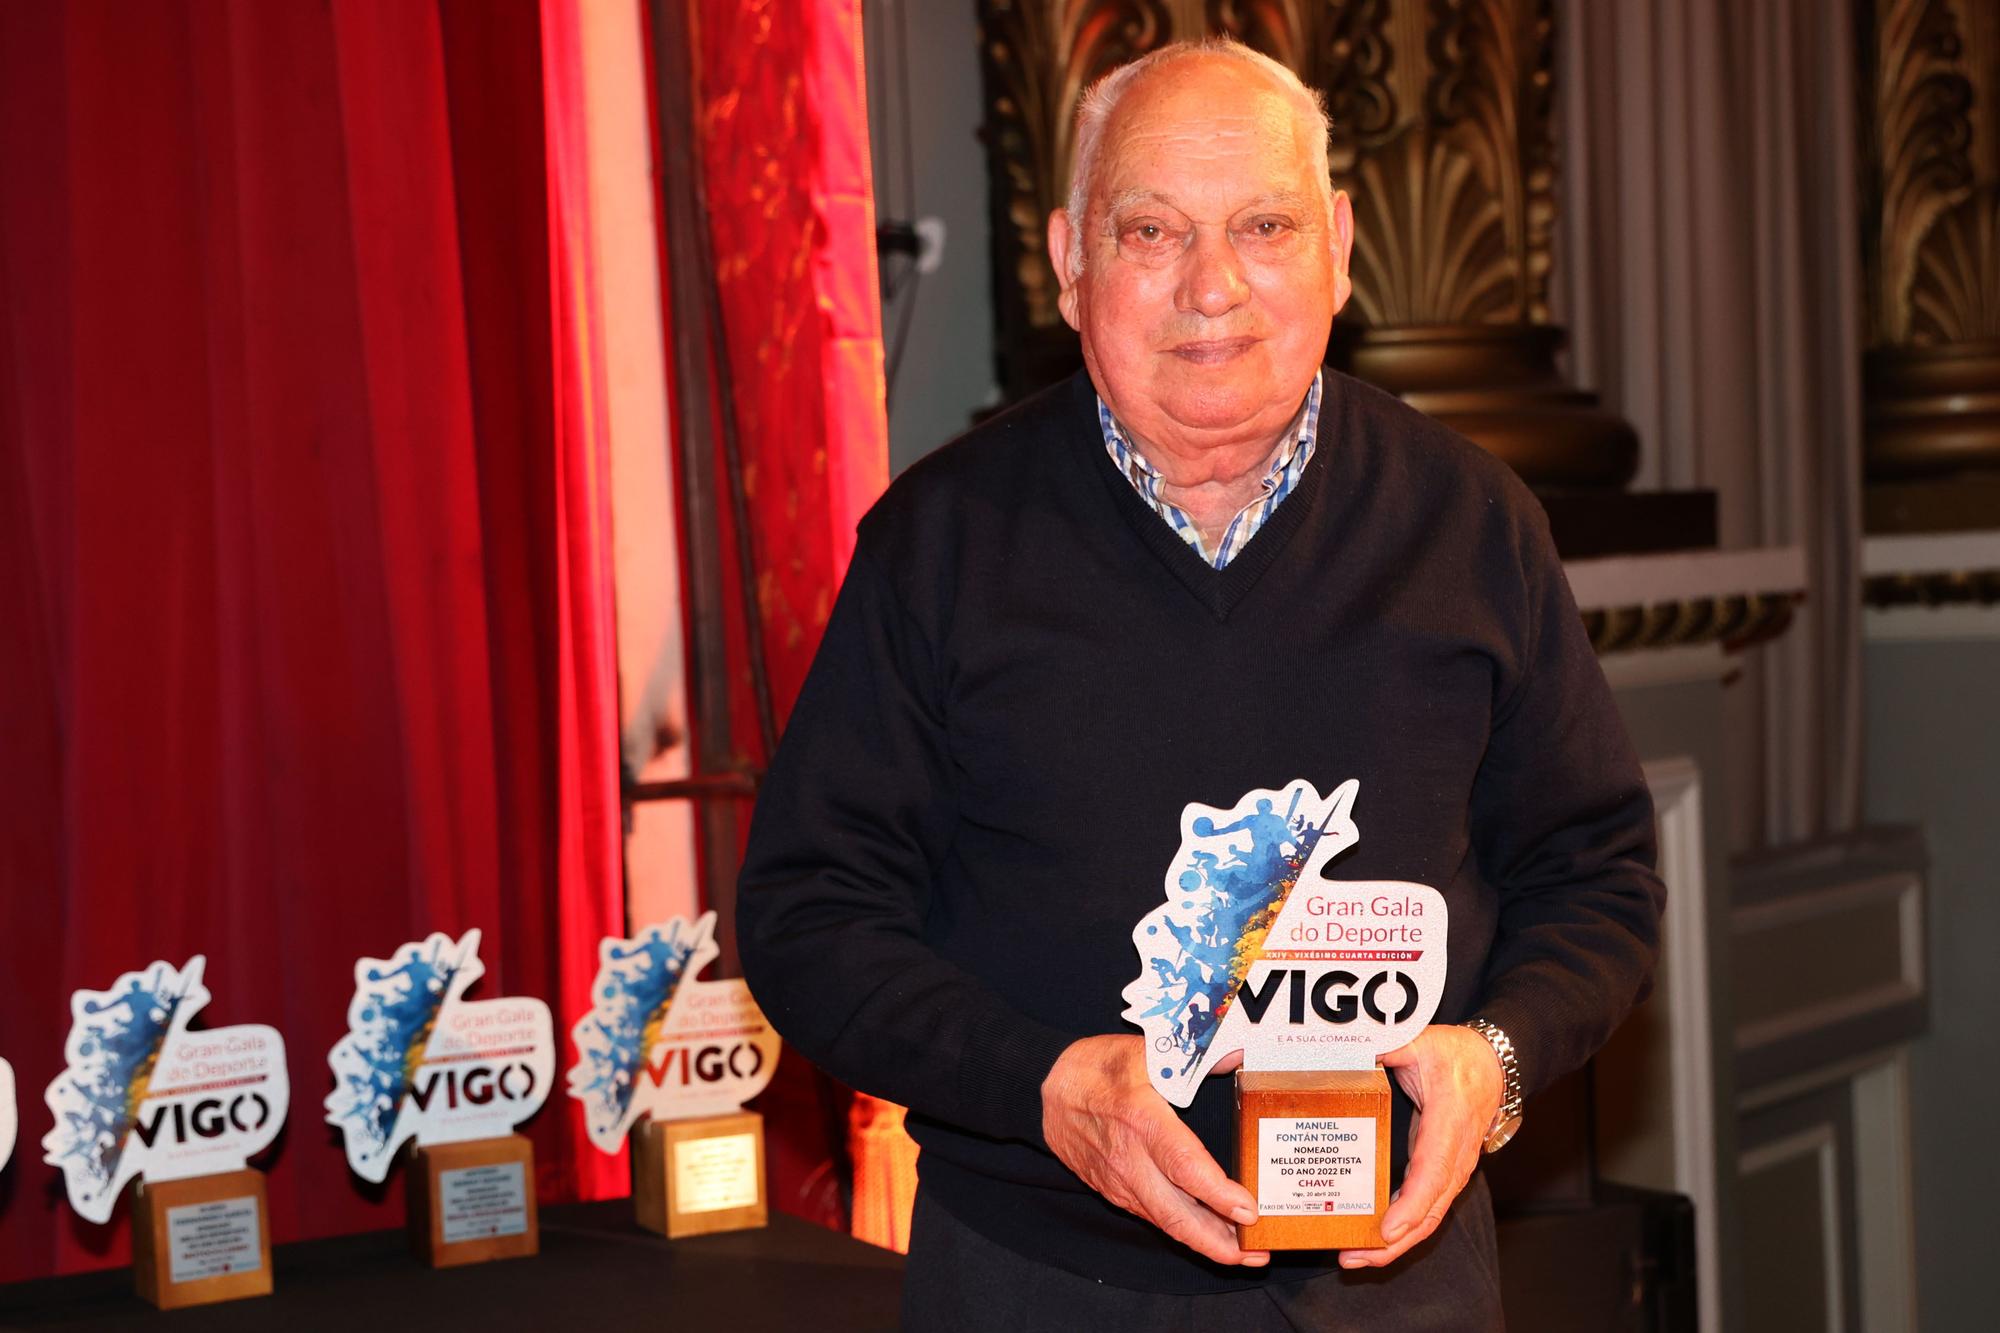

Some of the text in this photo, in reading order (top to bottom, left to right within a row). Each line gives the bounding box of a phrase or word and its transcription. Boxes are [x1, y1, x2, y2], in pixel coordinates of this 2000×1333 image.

[1306, 896, 1423, 917] Gran Gala
[1290, 922, 1422, 946] do Deporte
[1376, 951, 1412, 960] EDICIÓN
[1237, 969, 1419, 1026] VIGO
[1319, 1035, 1372, 1043] COMARCA
[646, 1041, 763, 1088] VIGO
[410, 1062, 537, 1113] VIGO
[134, 1092, 270, 1148] VIGO
[1295, 1121, 1339, 1130] MANUEL
[1276, 1132, 1358, 1142] FONTÁN TOMBO
[1293, 1146, 1339, 1154] NOMEADO
[1270, 1156, 1362, 1165] MELLOR DEPORTISTA
[1281, 1167, 1351, 1176] DO ANO 2022 EN
[1298, 1179, 1334, 1188] CHAVE
